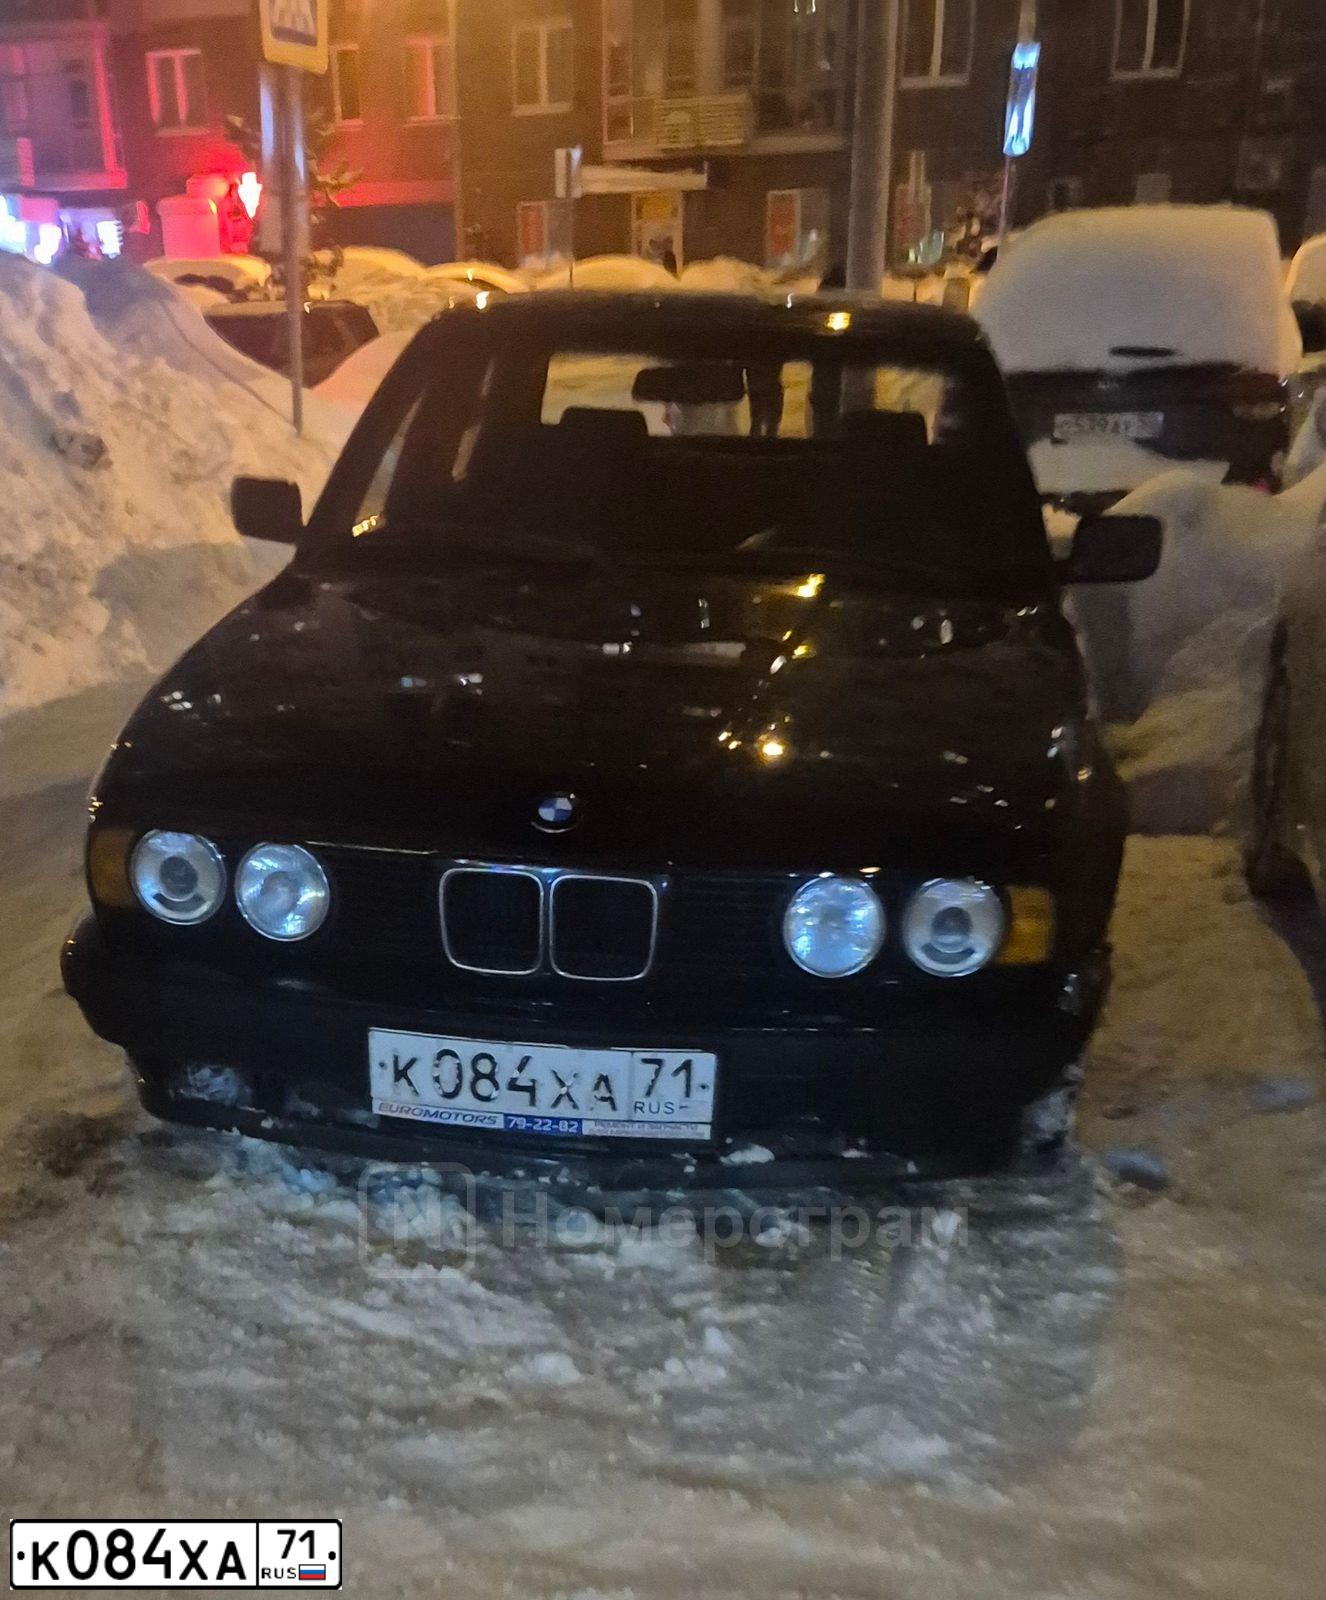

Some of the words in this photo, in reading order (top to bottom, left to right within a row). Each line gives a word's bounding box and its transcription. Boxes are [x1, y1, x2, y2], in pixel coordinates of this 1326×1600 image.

[392, 1047, 618, 1112] К084ХА
[641, 1057, 693, 1099] 71
[378, 1101, 498, 1125] EUROMOTORS
[633, 1101, 683, 1116] RUS
